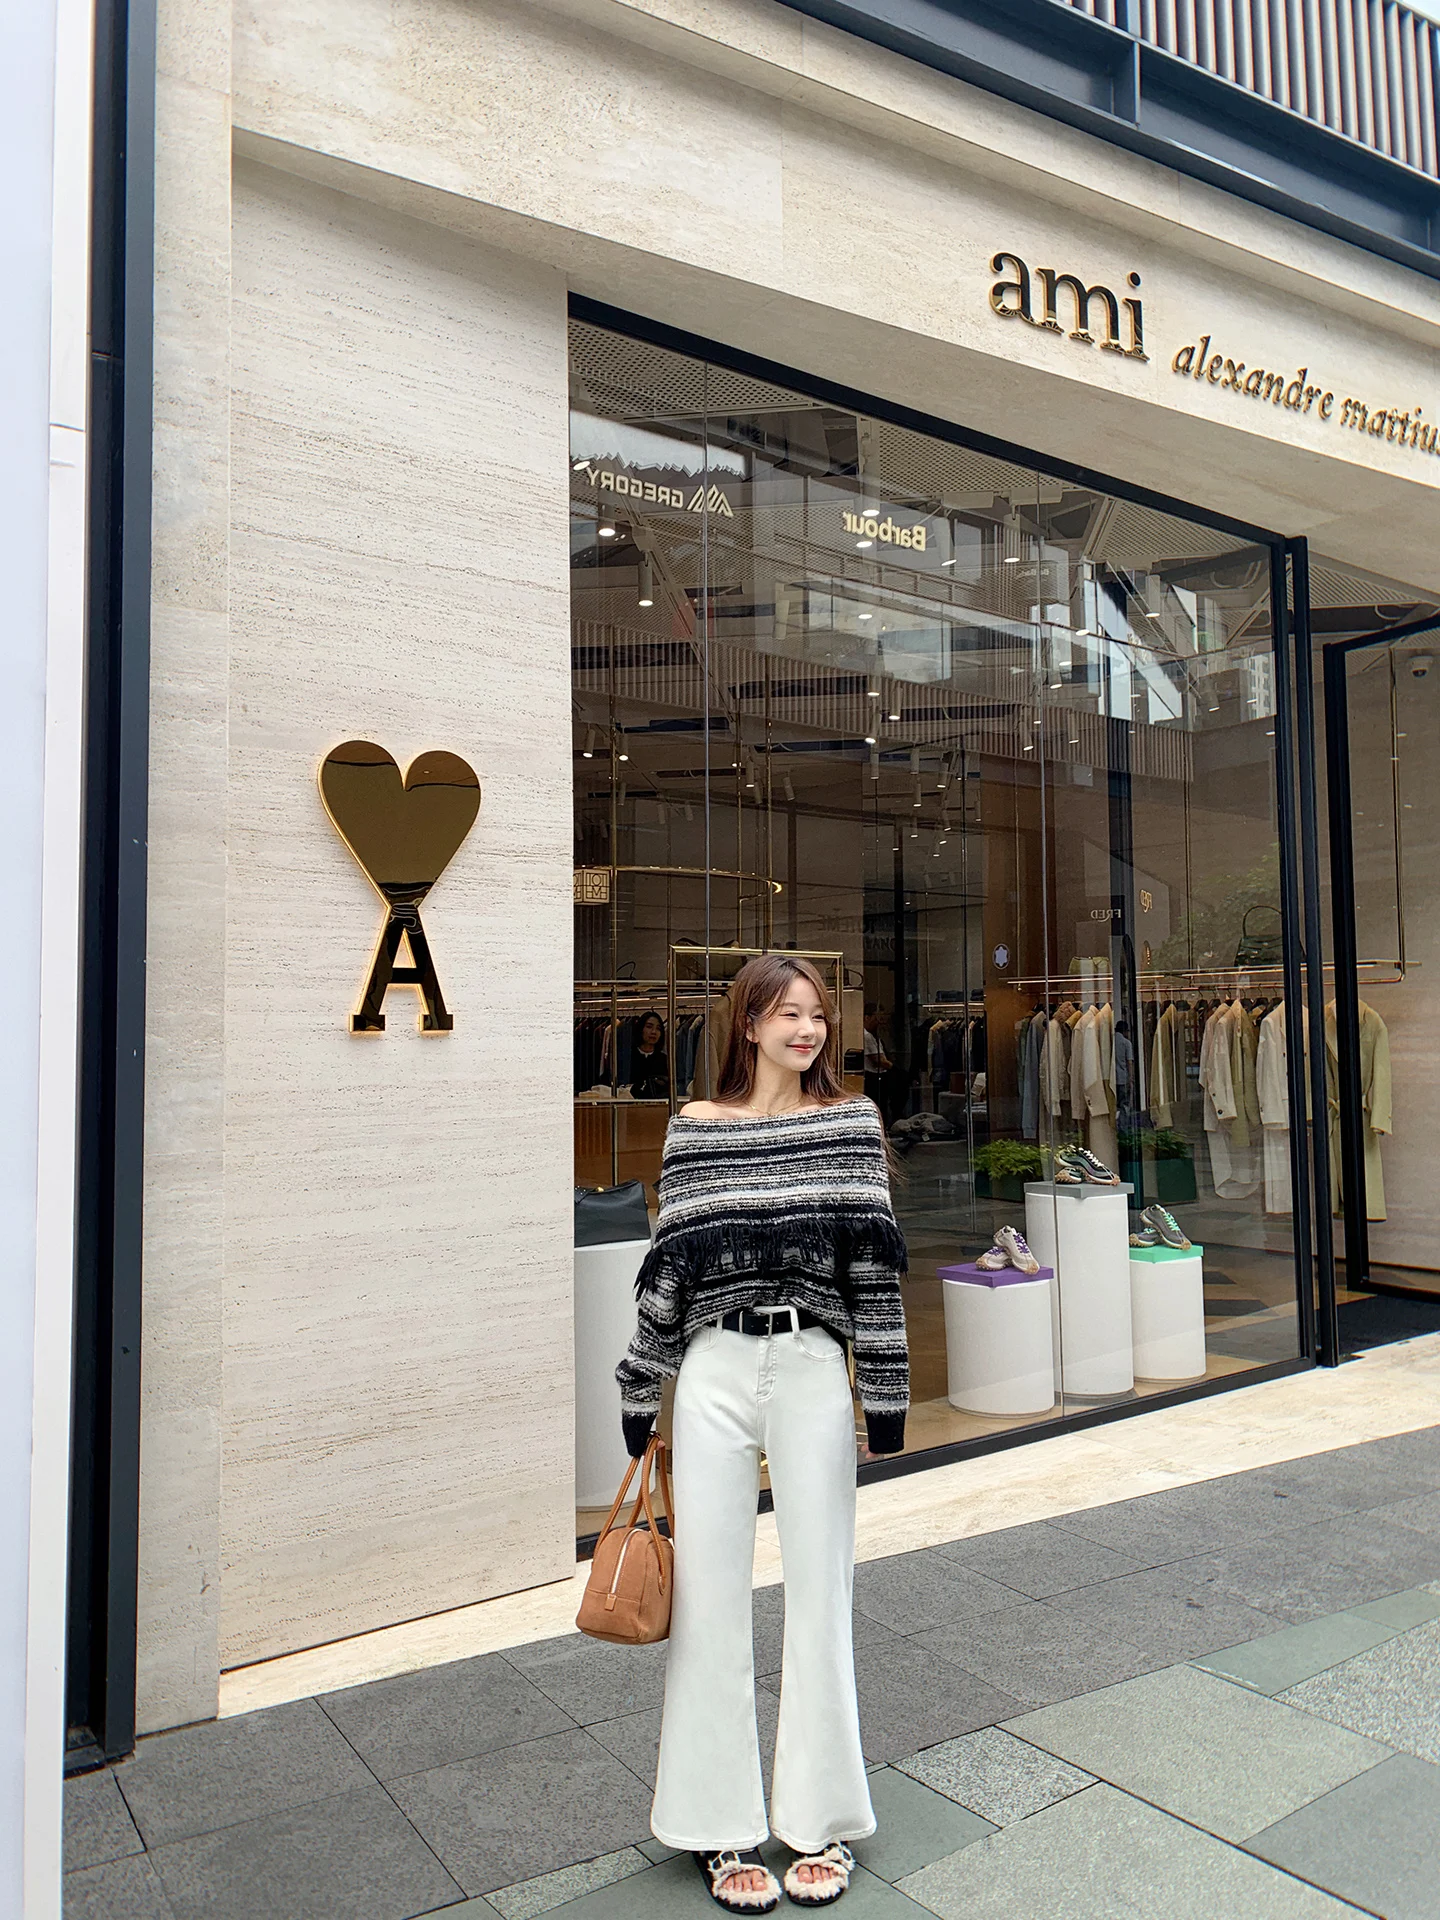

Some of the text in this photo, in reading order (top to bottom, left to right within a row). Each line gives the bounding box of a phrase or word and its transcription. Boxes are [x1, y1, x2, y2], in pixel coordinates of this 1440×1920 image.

[990, 251, 1150, 363] ami
[1172, 335, 1440, 456] alexandre mattiu
